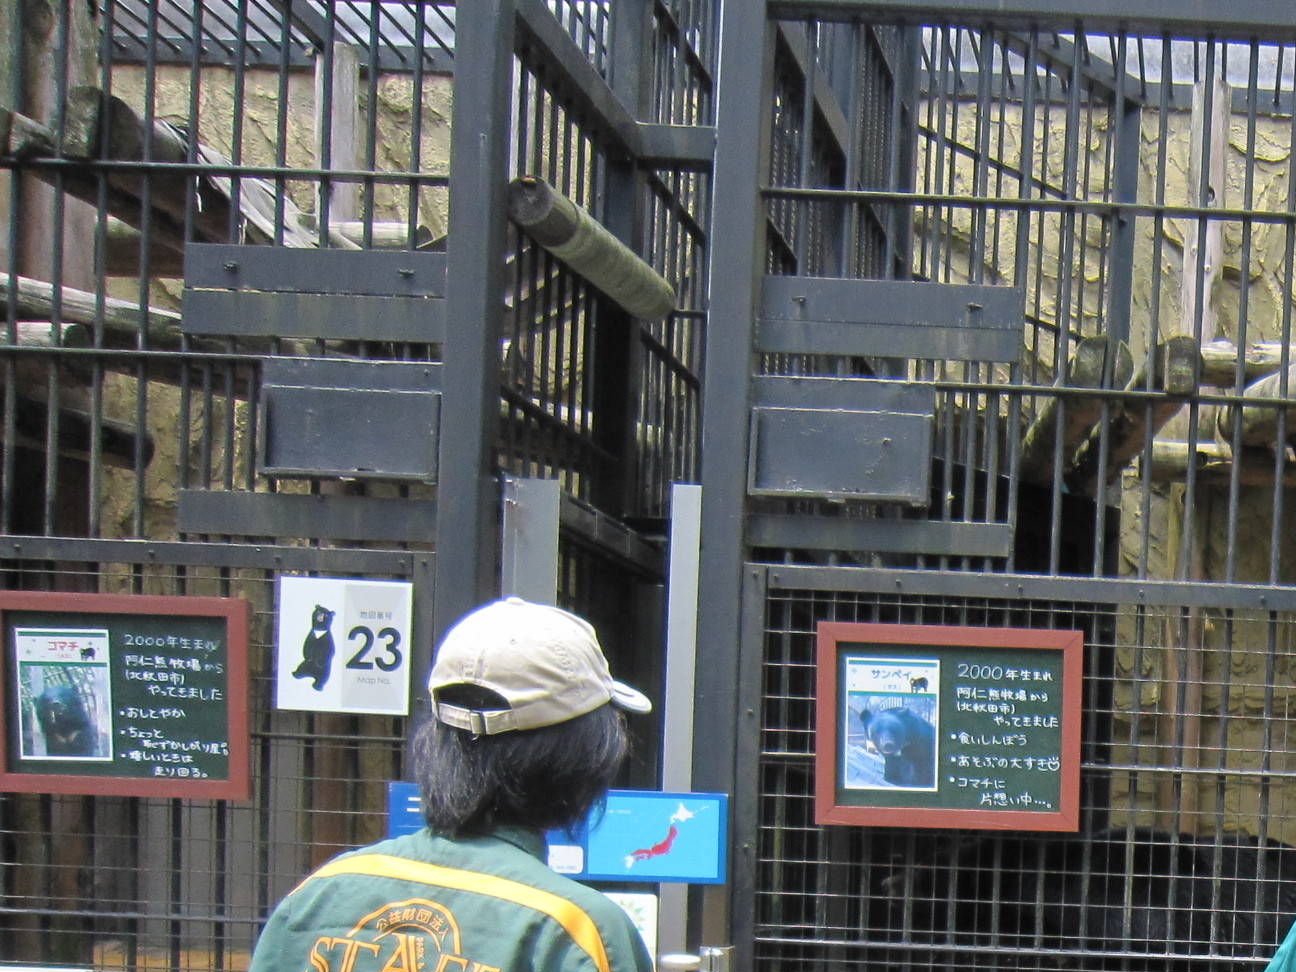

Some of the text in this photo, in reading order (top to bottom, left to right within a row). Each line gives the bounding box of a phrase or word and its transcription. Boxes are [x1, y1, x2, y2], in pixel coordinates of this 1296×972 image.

[47, 640, 79, 652] コマチ
[345, 625, 403, 673] 23
[356, 675, 376, 686] Map
[957, 663, 1054, 682] 2000年生まれ
[147, 684, 224, 701] やってきました
[956, 686, 1049, 703] 阿仁熊牧場から
[993, 715, 1060, 729] やってきました
[375, 906, 450, 942] 公益財団法人
